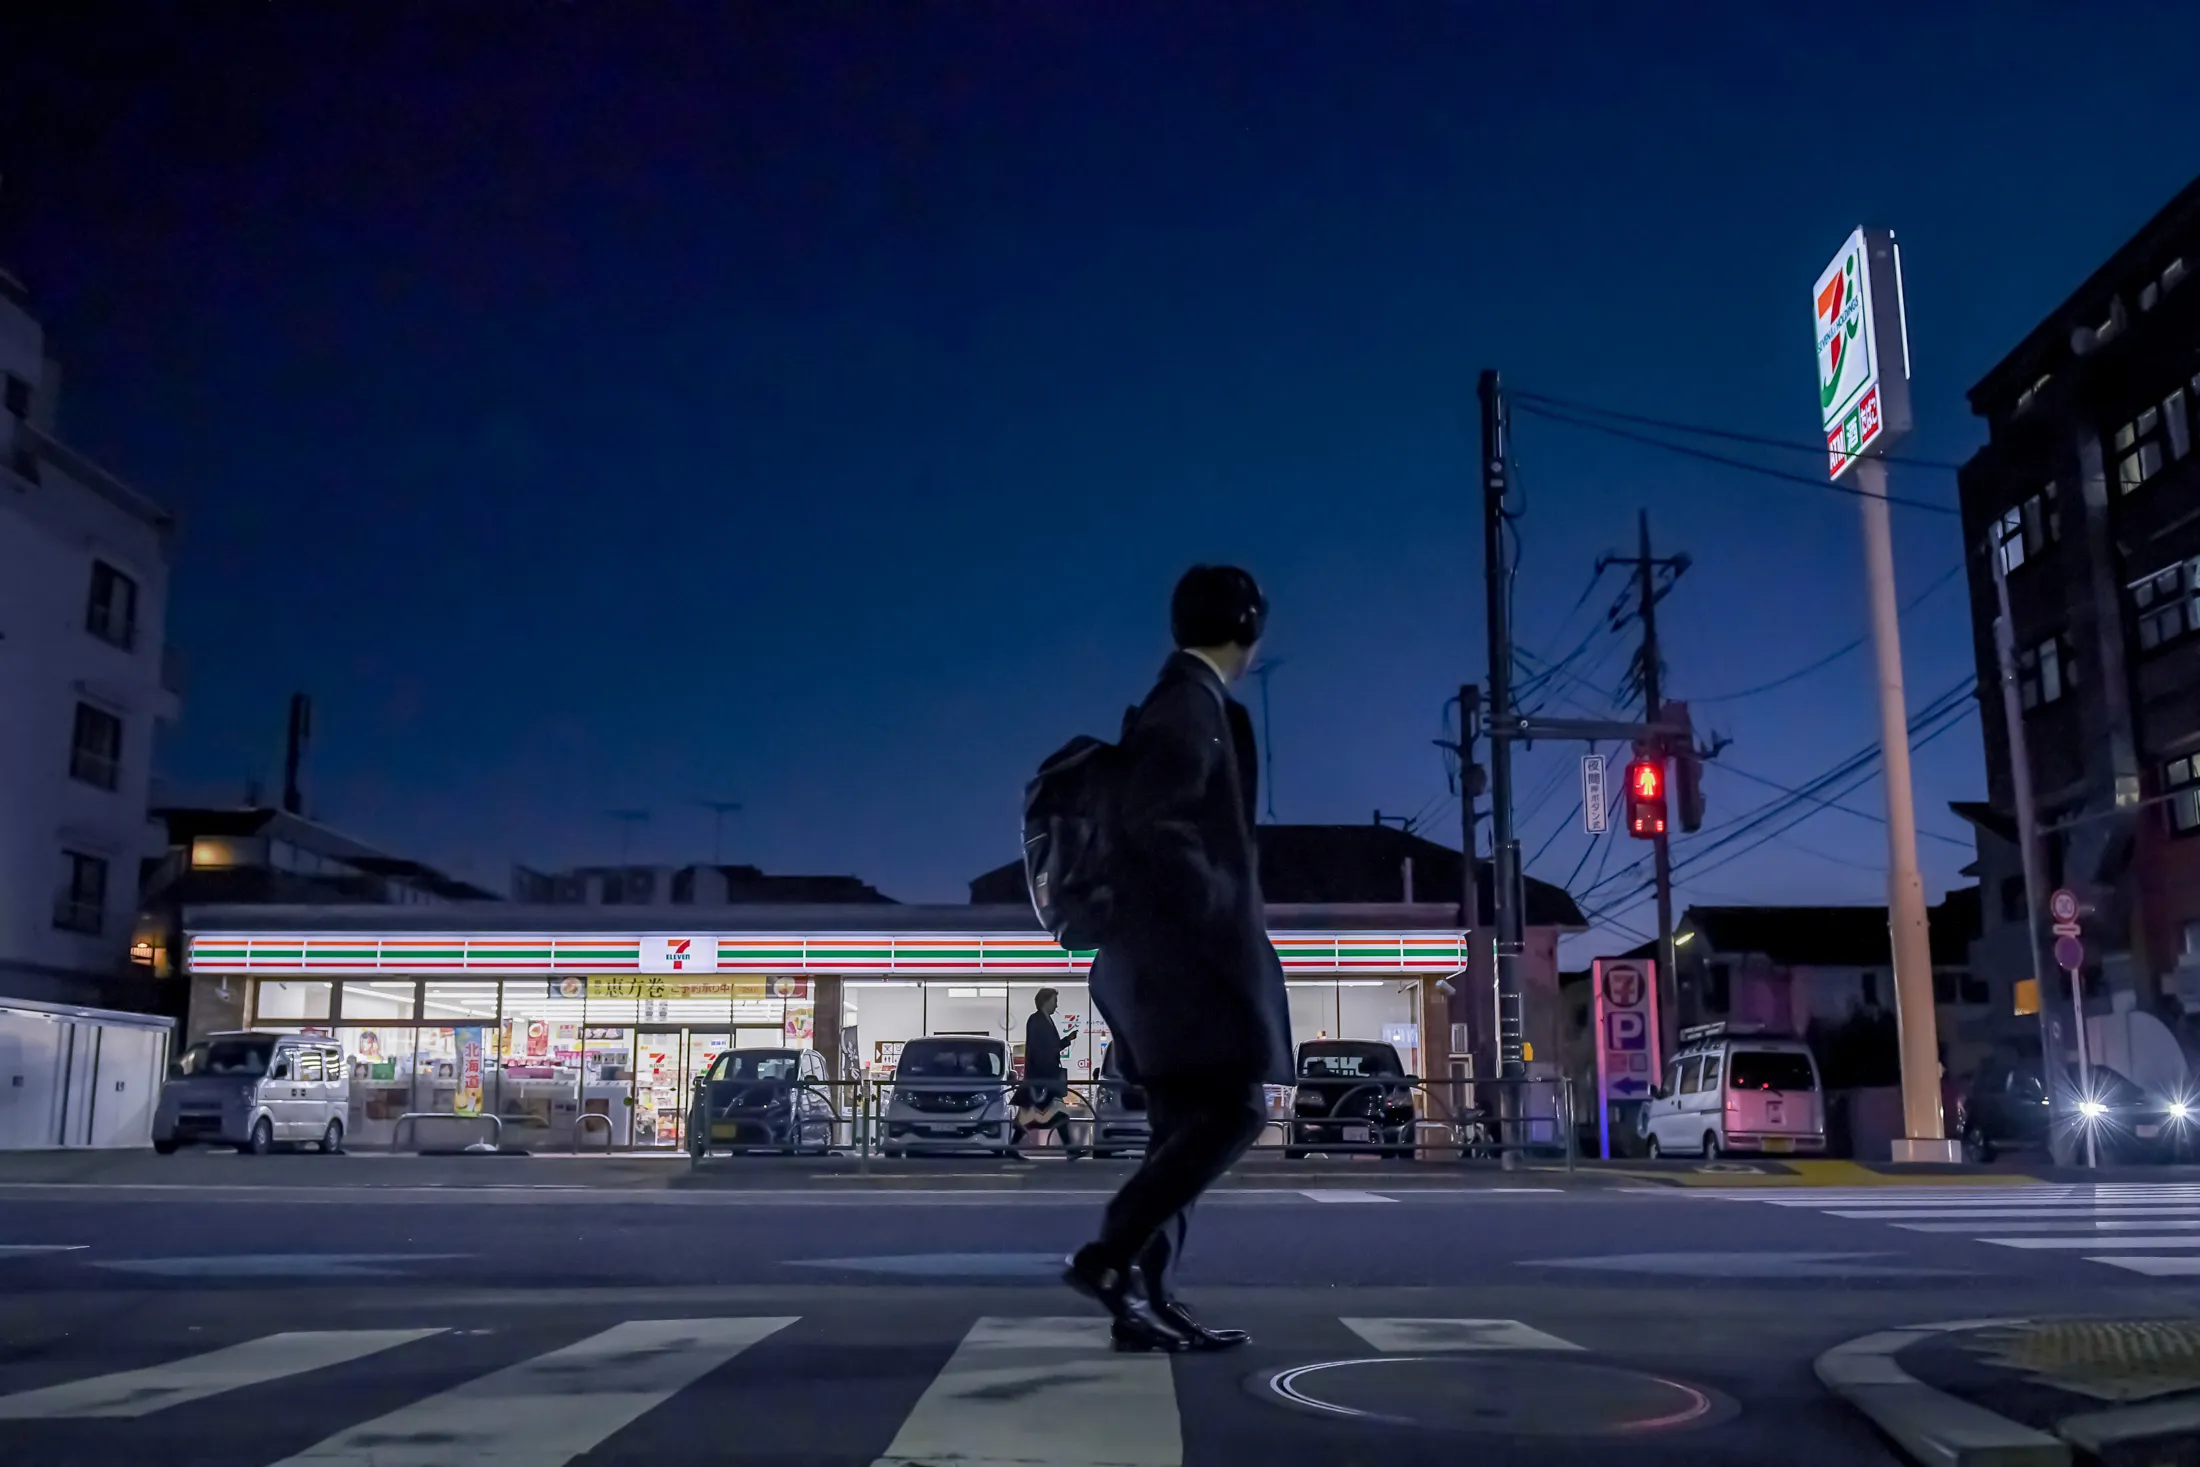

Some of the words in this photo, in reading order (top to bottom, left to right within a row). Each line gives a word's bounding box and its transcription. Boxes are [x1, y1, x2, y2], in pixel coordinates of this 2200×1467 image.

[1836, 294, 1860, 332] HOLDINGS
[1829, 430, 1845, 469] ATM
[1846, 415, 1859, 452] 酒
[605, 976, 665, 998] 恵方巻
[1612, 1014, 1642, 1050] P
[465, 1042, 479, 1089] 北海道
